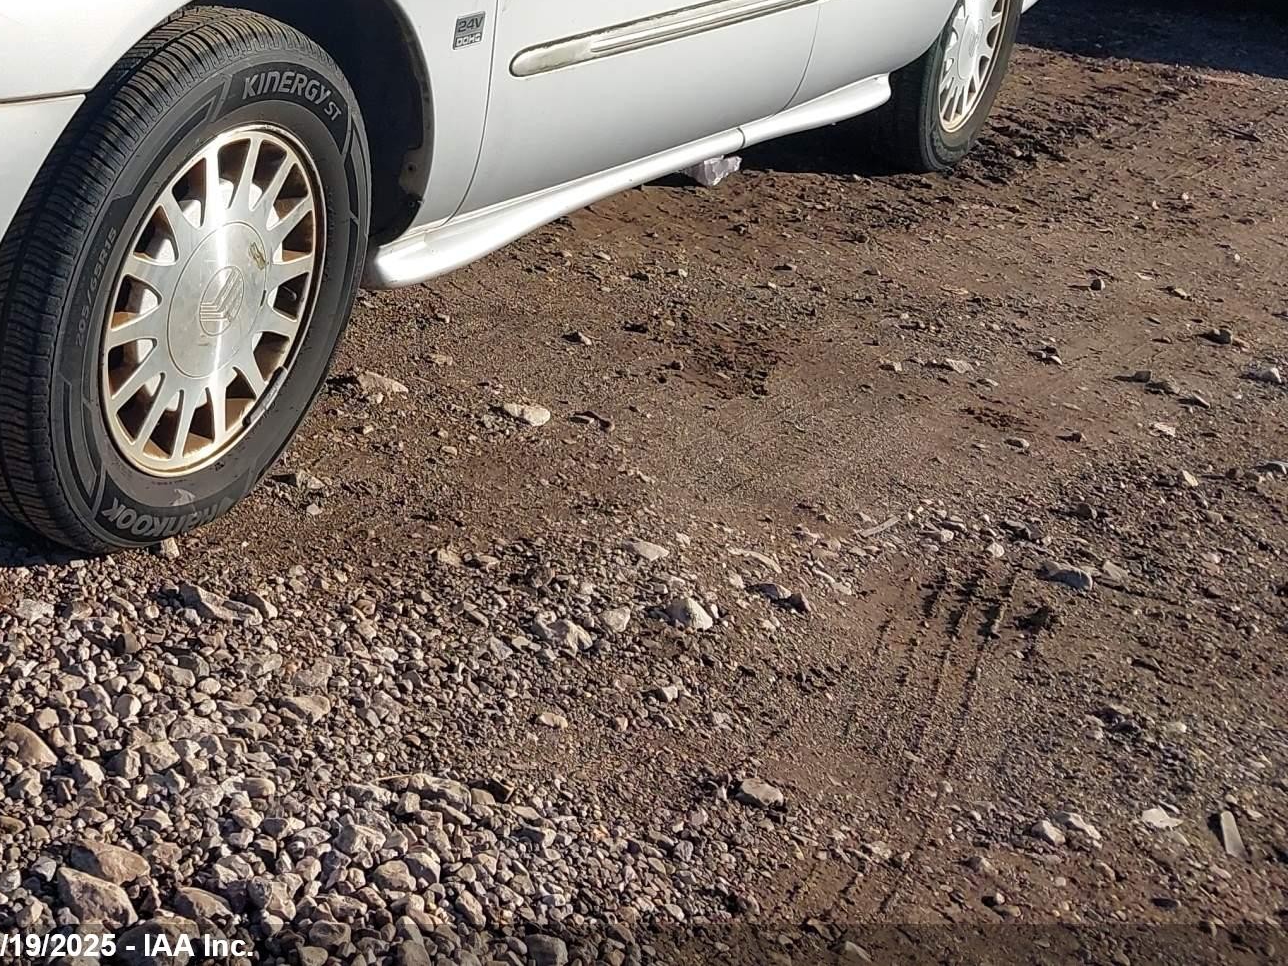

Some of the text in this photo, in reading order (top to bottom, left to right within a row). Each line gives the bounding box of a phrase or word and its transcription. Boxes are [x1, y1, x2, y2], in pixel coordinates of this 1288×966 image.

[458, 16, 484, 33] 24V
[456, 32, 481, 46] DOHC
[242, 71, 342, 121] KINERGY ST
